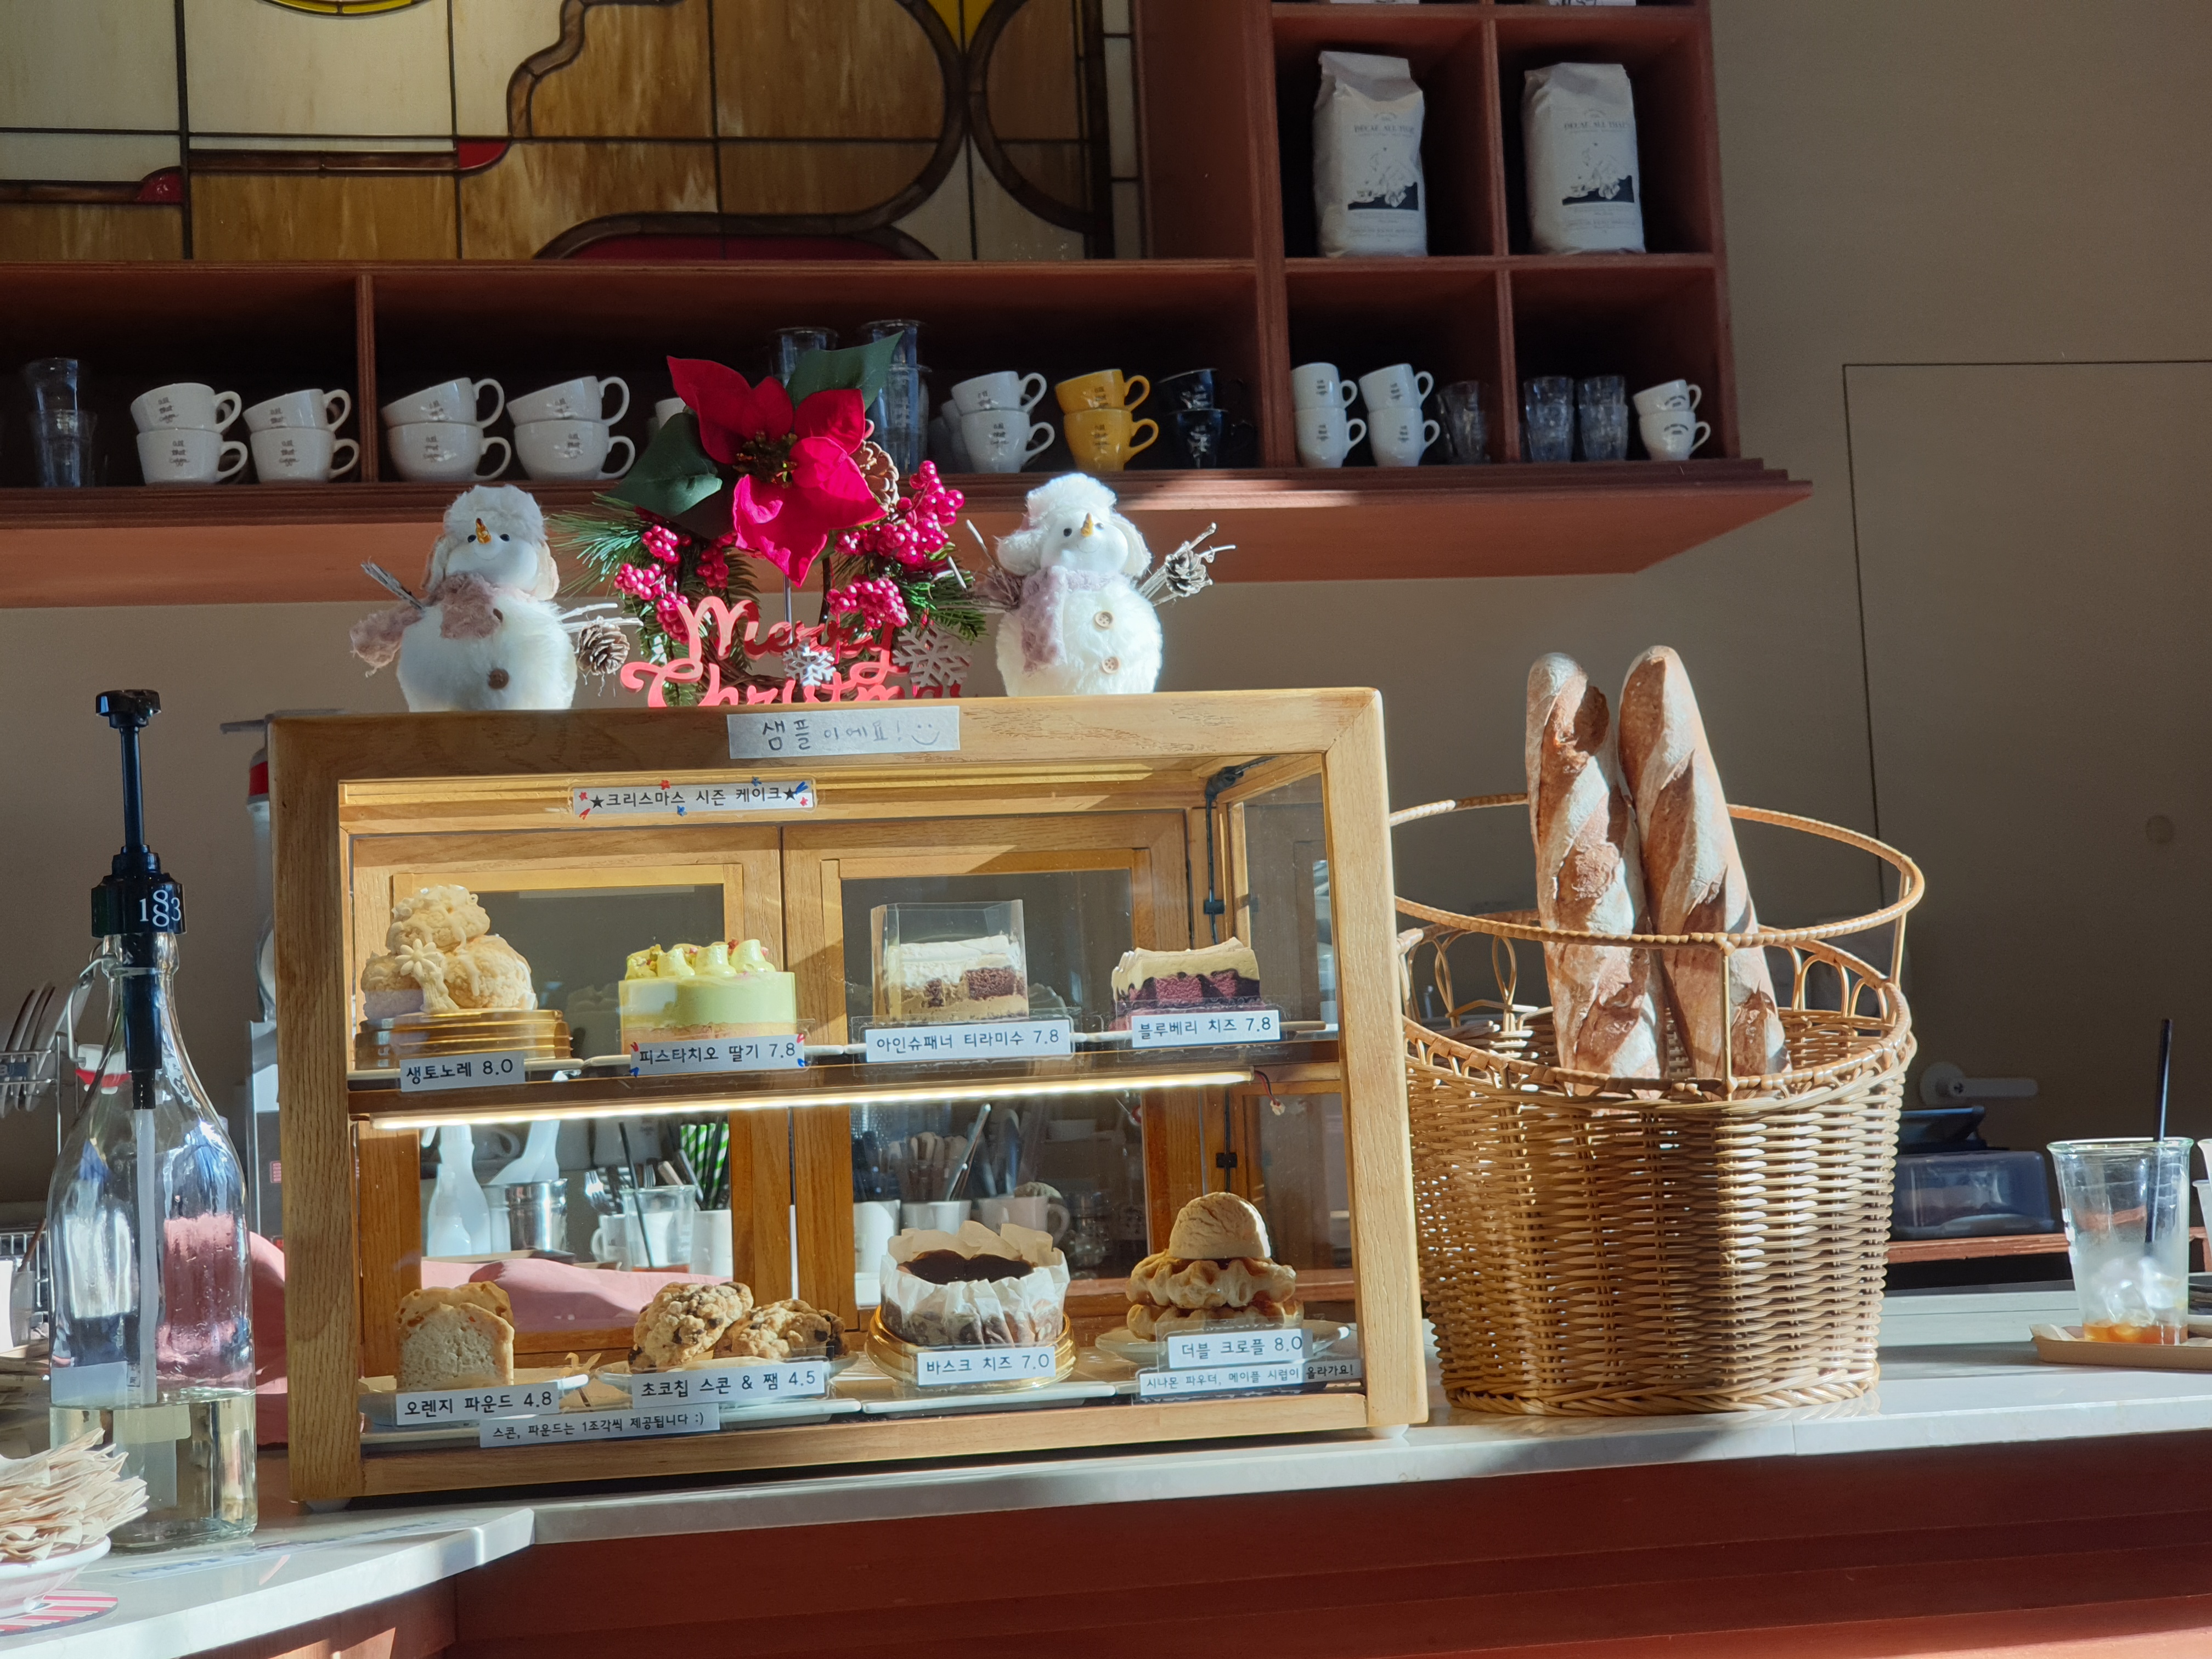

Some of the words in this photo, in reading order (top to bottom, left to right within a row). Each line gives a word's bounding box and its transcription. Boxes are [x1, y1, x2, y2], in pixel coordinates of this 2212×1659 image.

[606, 789, 686, 808] 크리스마스
[696, 788, 726, 806] 시즌
[735, 785, 783, 802] 케이크
[1138, 1020, 1198, 1040] 블루베리
[1208, 1018, 1238, 1033] 치즈
[1245, 1017, 1272, 1032] 7.8
[639, 1047, 719, 1065] 피스타치오
[729, 1043, 759, 1063] 딸기
[769, 1042, 795, 1058] 7.8
[876, 1034, 953, 1054] 아인슈패너
[964, 1030, 1024, 1048] 티라미수
[1032, 1029, 1059, 1045] 7.8
[407, 1062, 472, 1085] 생토노레
[482, 1058, 514, 1075] 8.0
[1181, 1342, 1211, 1360] 더블
[1220, 1338, 1266, 1356] 크로플
[1274, 1336, 1302, 1352] 8.0
[927, 1359, 972, 1375] 바스크
[983, 1356, 1013, 1372] 치즈
[1022, 1353, 1050, 1369] 7.0
[1146, 1376, 1179, 1389] 시나몬
[1186, 1374, 1222, 1386] 파우더,
[1228, 1370, 1261, 1383] 메이플
[1267, 1368, 1299, 1382] 시럽이
[1306, 1363, 1353, 1379] 올라가요!
[641, 1380, 690, 1398] 초코칩
[699, 1377, 731, 1393] 스콘
[741, 1375, 753, 1390] &
[763, 1373, 780, 1390] 쨈
[788, 1372, 815, 1386] 4.5
[404, 1398, 453, 1418] 오렌지
[464, 1394, 514, 1413] 파운드
[523, 1391, 552, 1408] 4.8
[527, 1421, 575, 1436] 파운드는
[582, 1418, 623, 1432] 1조각씩
[629, 1413, 687, 1429] 제공됩니다
